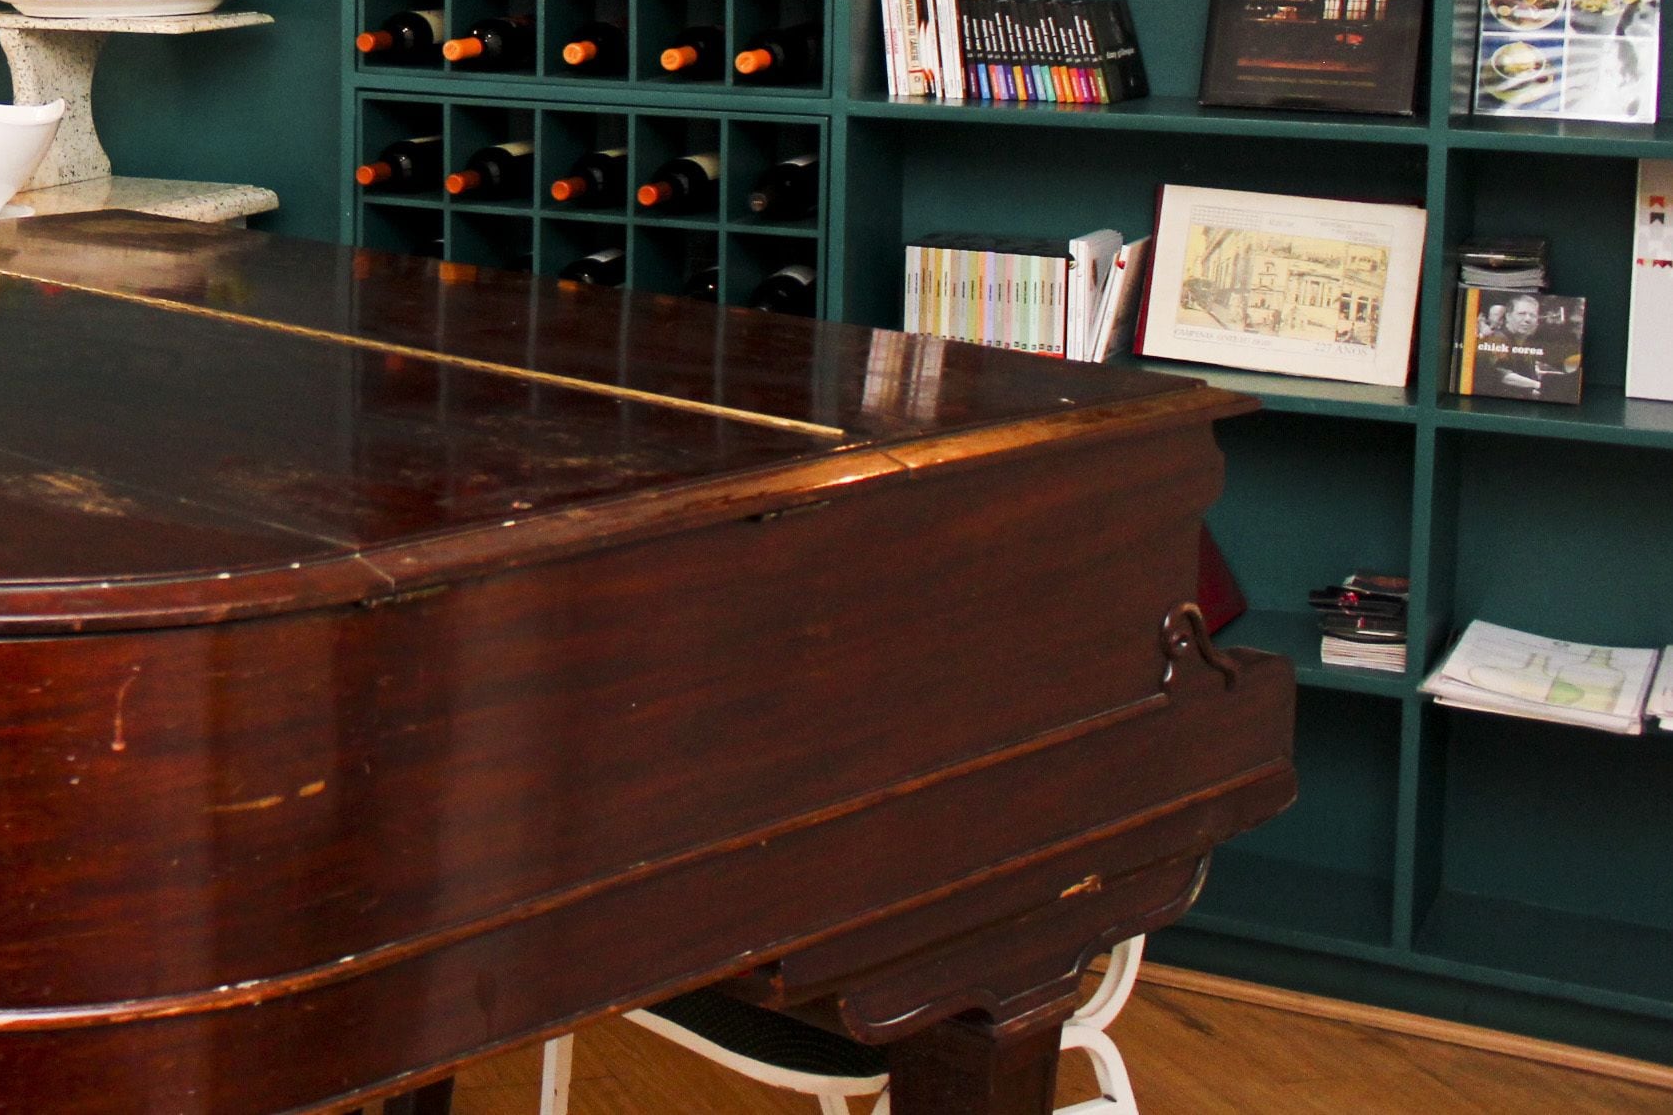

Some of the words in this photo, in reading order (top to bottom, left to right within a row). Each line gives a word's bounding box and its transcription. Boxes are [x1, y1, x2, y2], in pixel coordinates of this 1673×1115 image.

[1335, 345, 1369, 357] ANOS
[1478, 342, 1509, 353] chick
[1512, 345, 1544, 356] corea
